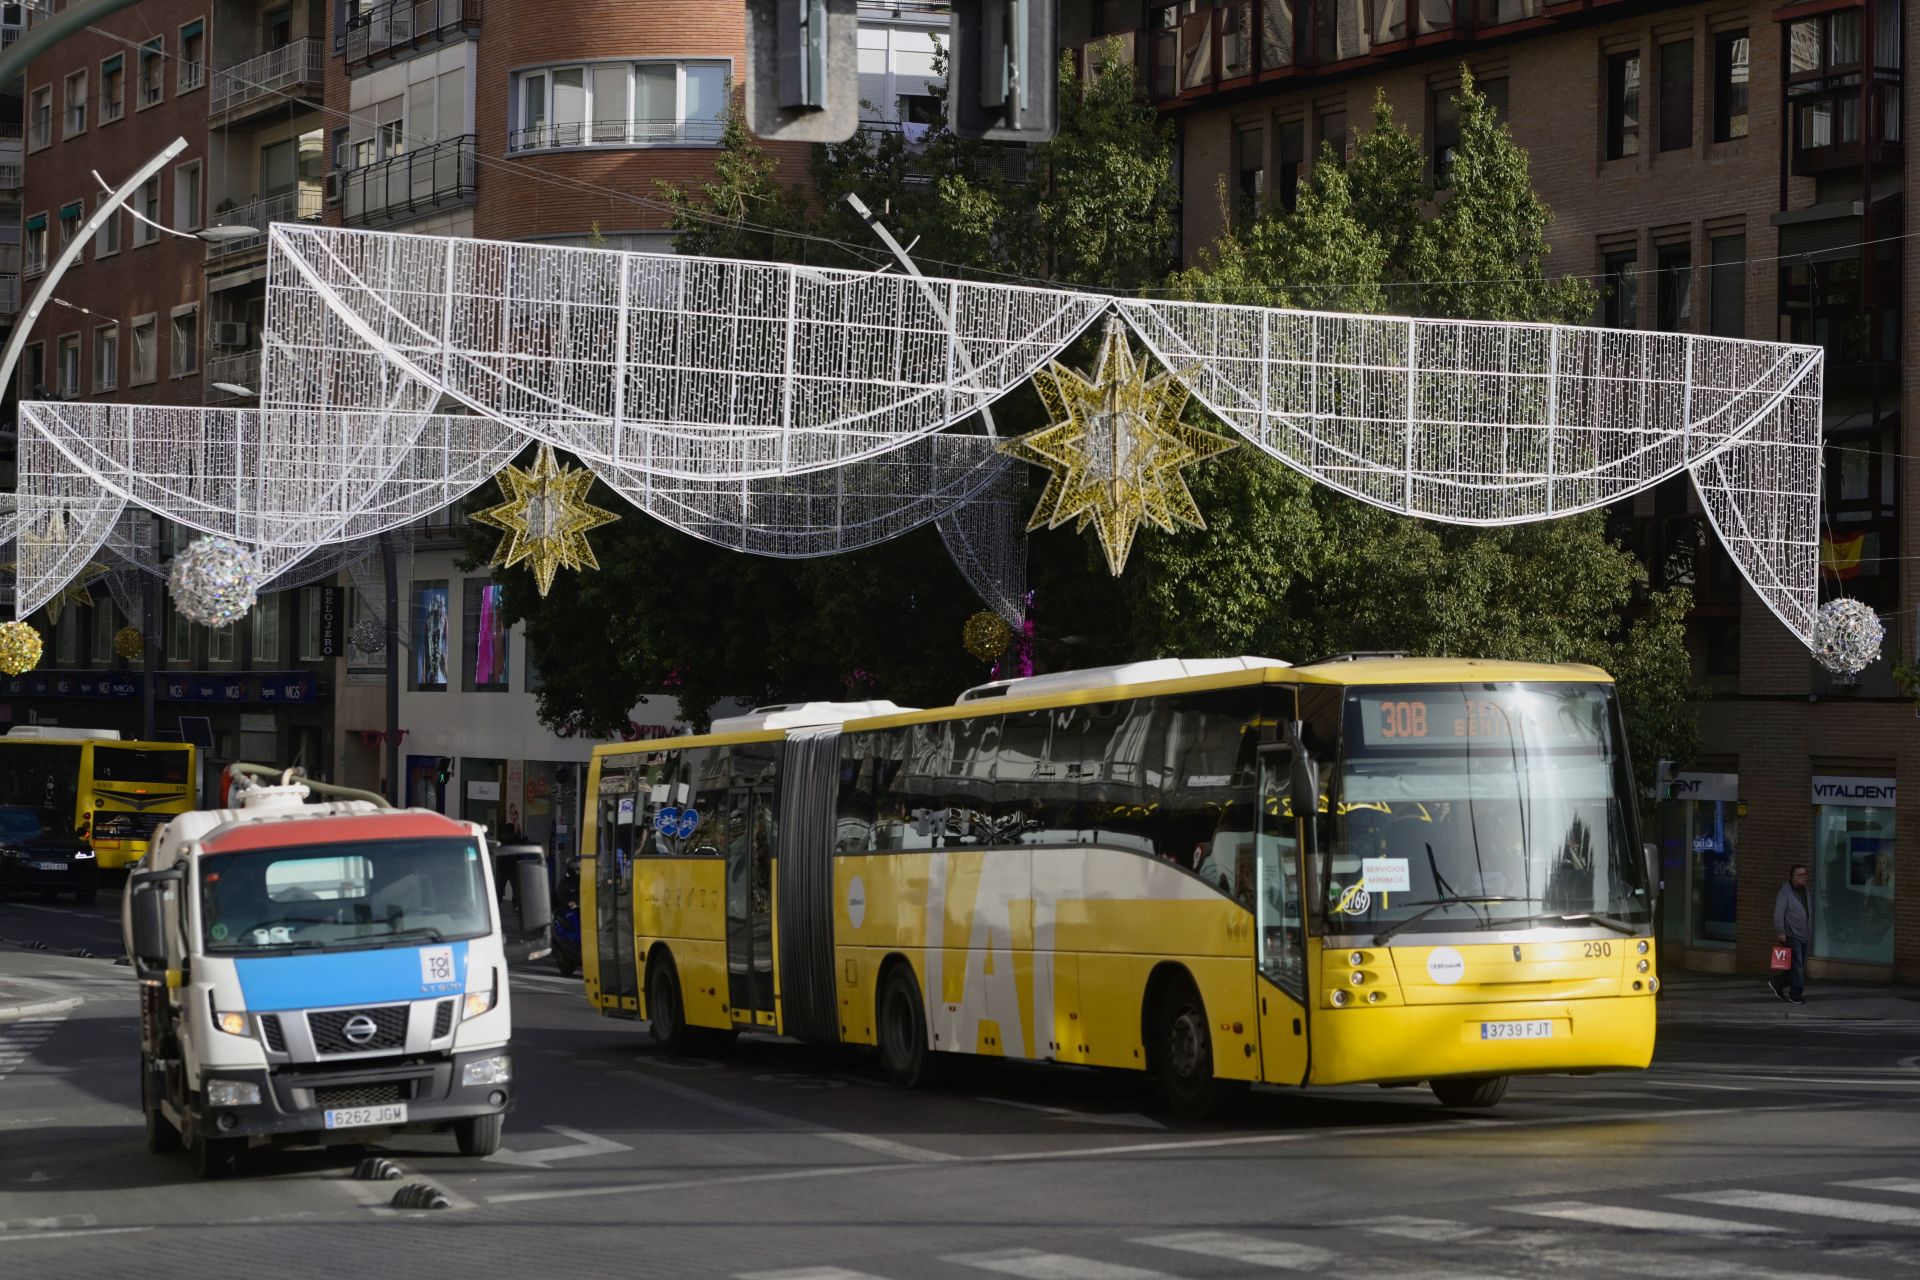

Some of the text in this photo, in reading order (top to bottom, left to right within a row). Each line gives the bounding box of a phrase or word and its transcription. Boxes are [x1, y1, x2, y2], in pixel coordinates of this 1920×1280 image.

[323, 588, 334, 655] RELOJERO
[113, 684, 135, 693] MGS
[169, 685, 183, 698] MGS
[225, 686, 240, 698] MGS
[285, 685, 300, 699] MGS
[1814, 784, 1896, 799] VITALDENT
[1366, 865, 1405, 873] SERVICIOS
[1583, 942, 1611, 958] 290
[1490, 1022, 1550, 1038] 3739 FJT
[335, 1109, 371, 1125] 6262
